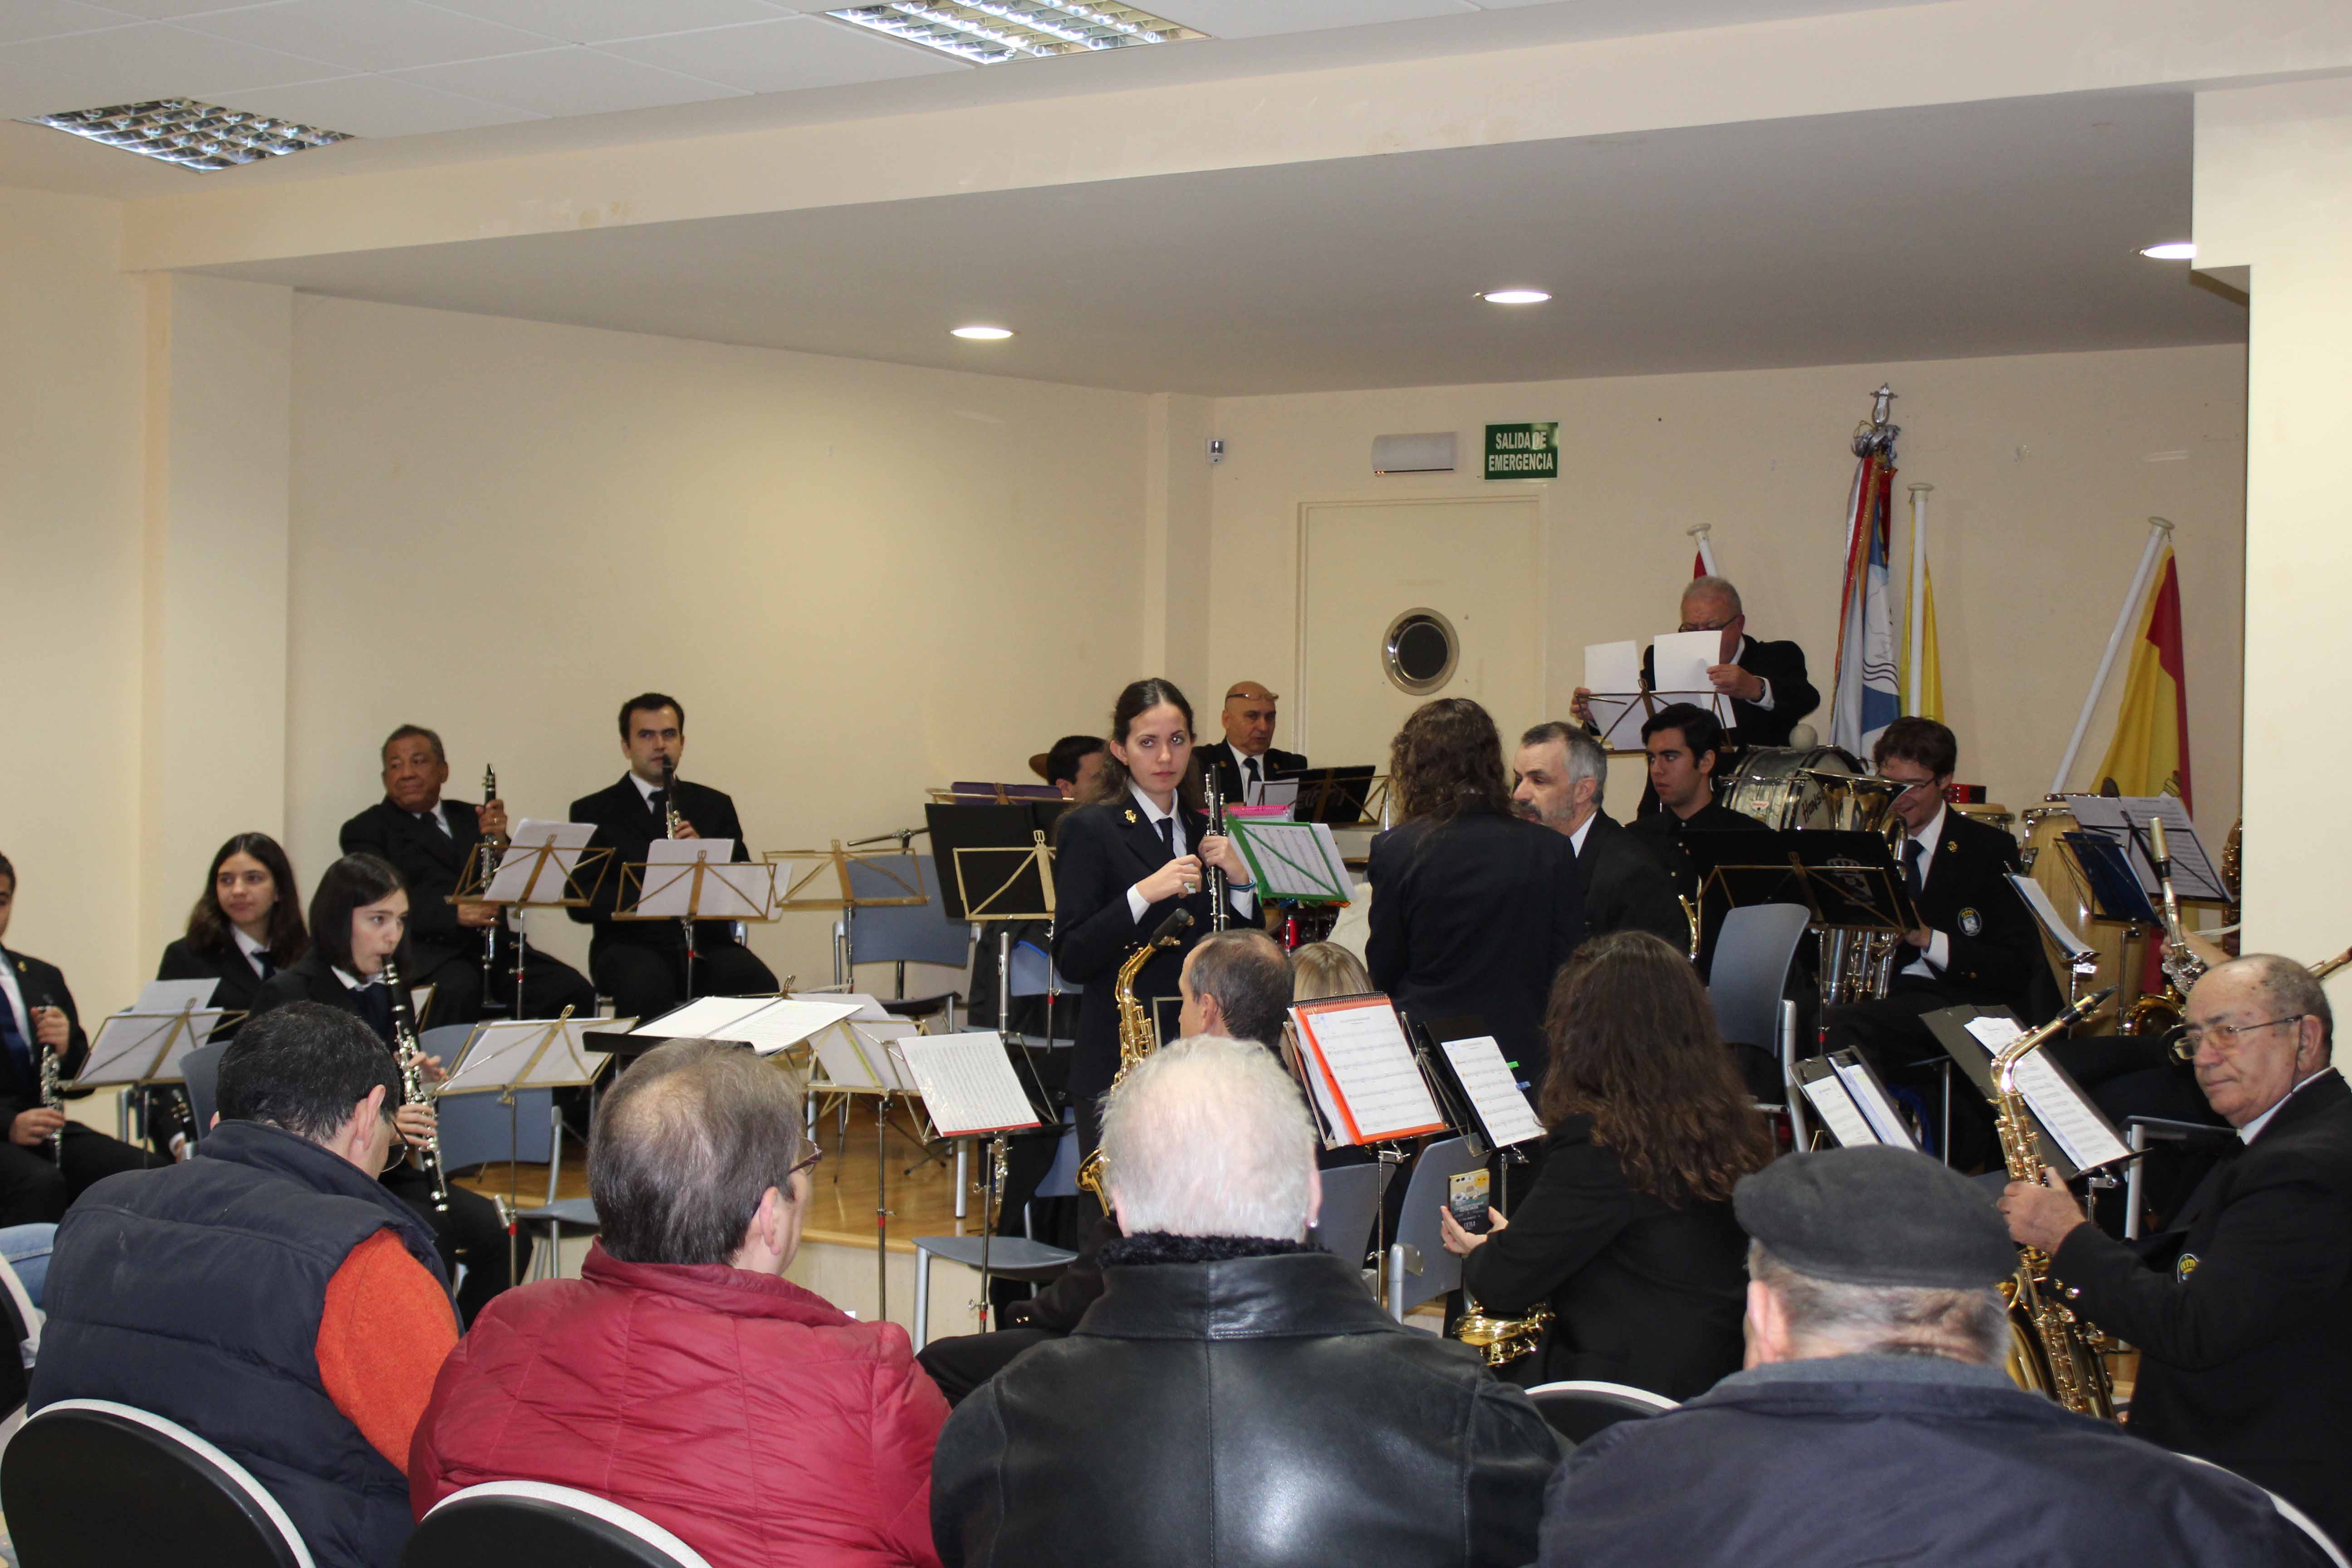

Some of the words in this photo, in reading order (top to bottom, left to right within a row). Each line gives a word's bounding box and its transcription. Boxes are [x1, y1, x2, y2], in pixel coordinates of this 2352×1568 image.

[1495, 432, 1531, 450] SALIDA
[1532, 431, 1547, 450] DE
[1488, 453, 1554, 471] EMERGENCIA
